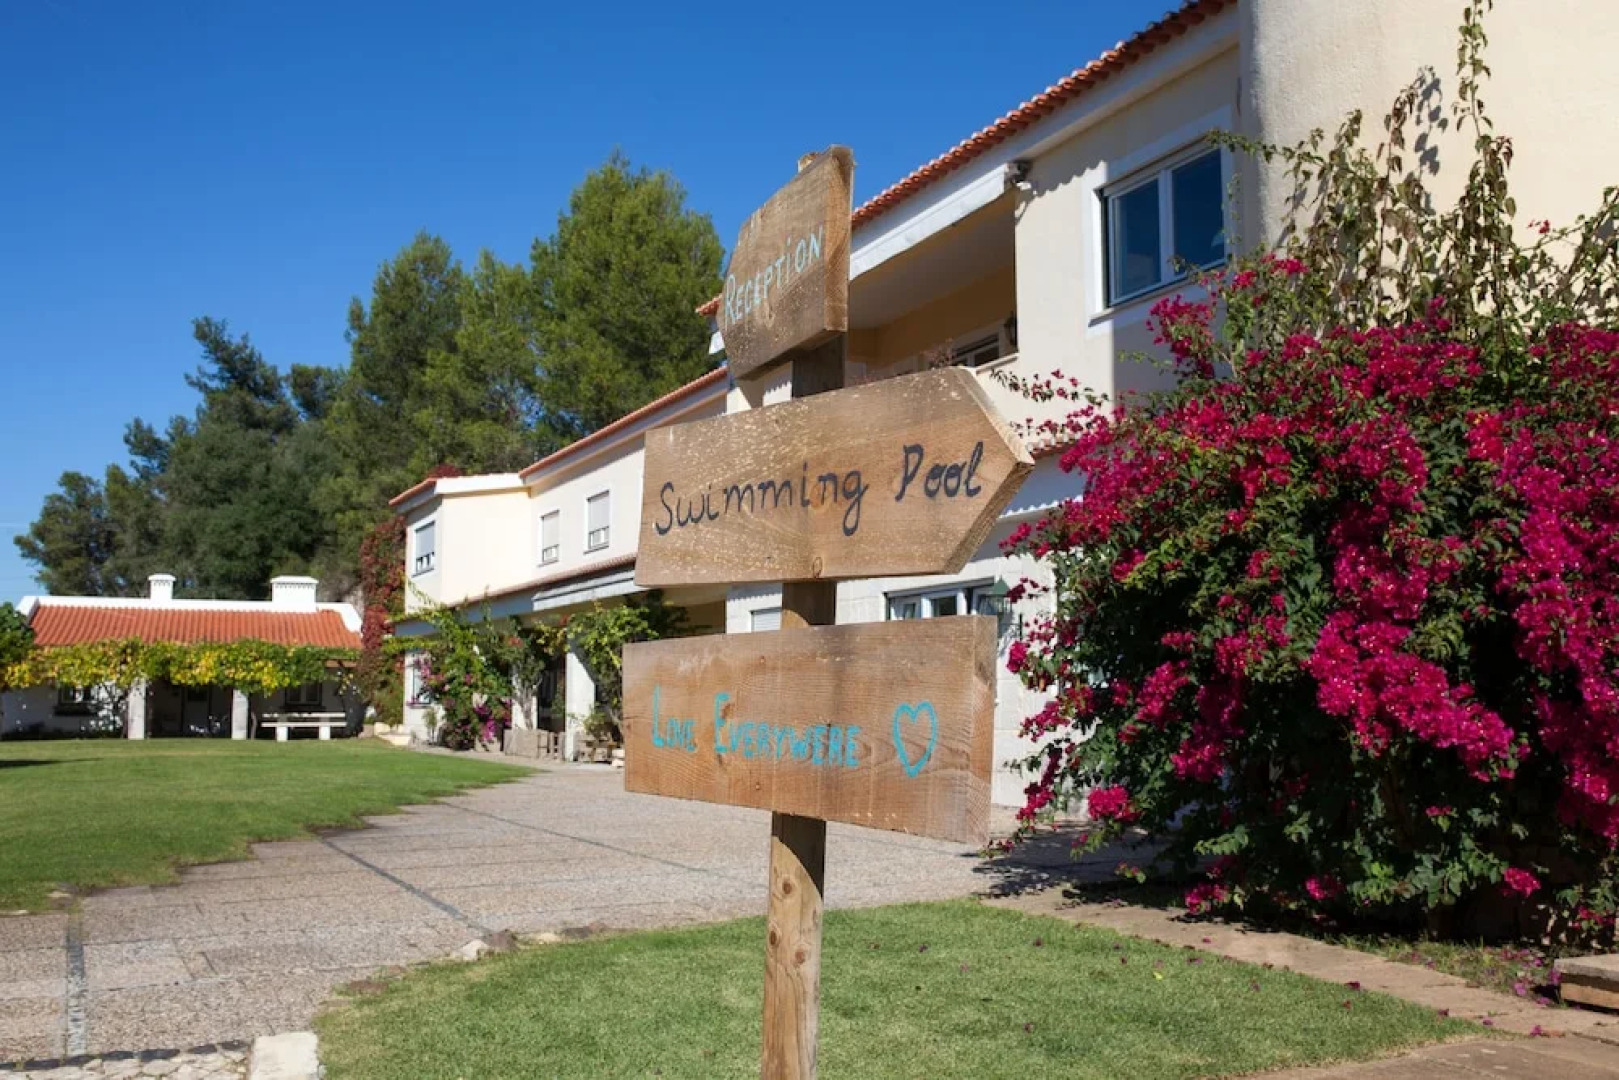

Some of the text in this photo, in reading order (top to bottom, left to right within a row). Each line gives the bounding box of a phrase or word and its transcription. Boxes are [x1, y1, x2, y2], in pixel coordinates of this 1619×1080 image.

[654, 441, 984, 537] Swimming Pool
[651, 684, 861, 768] LOVE EVERYWERE
